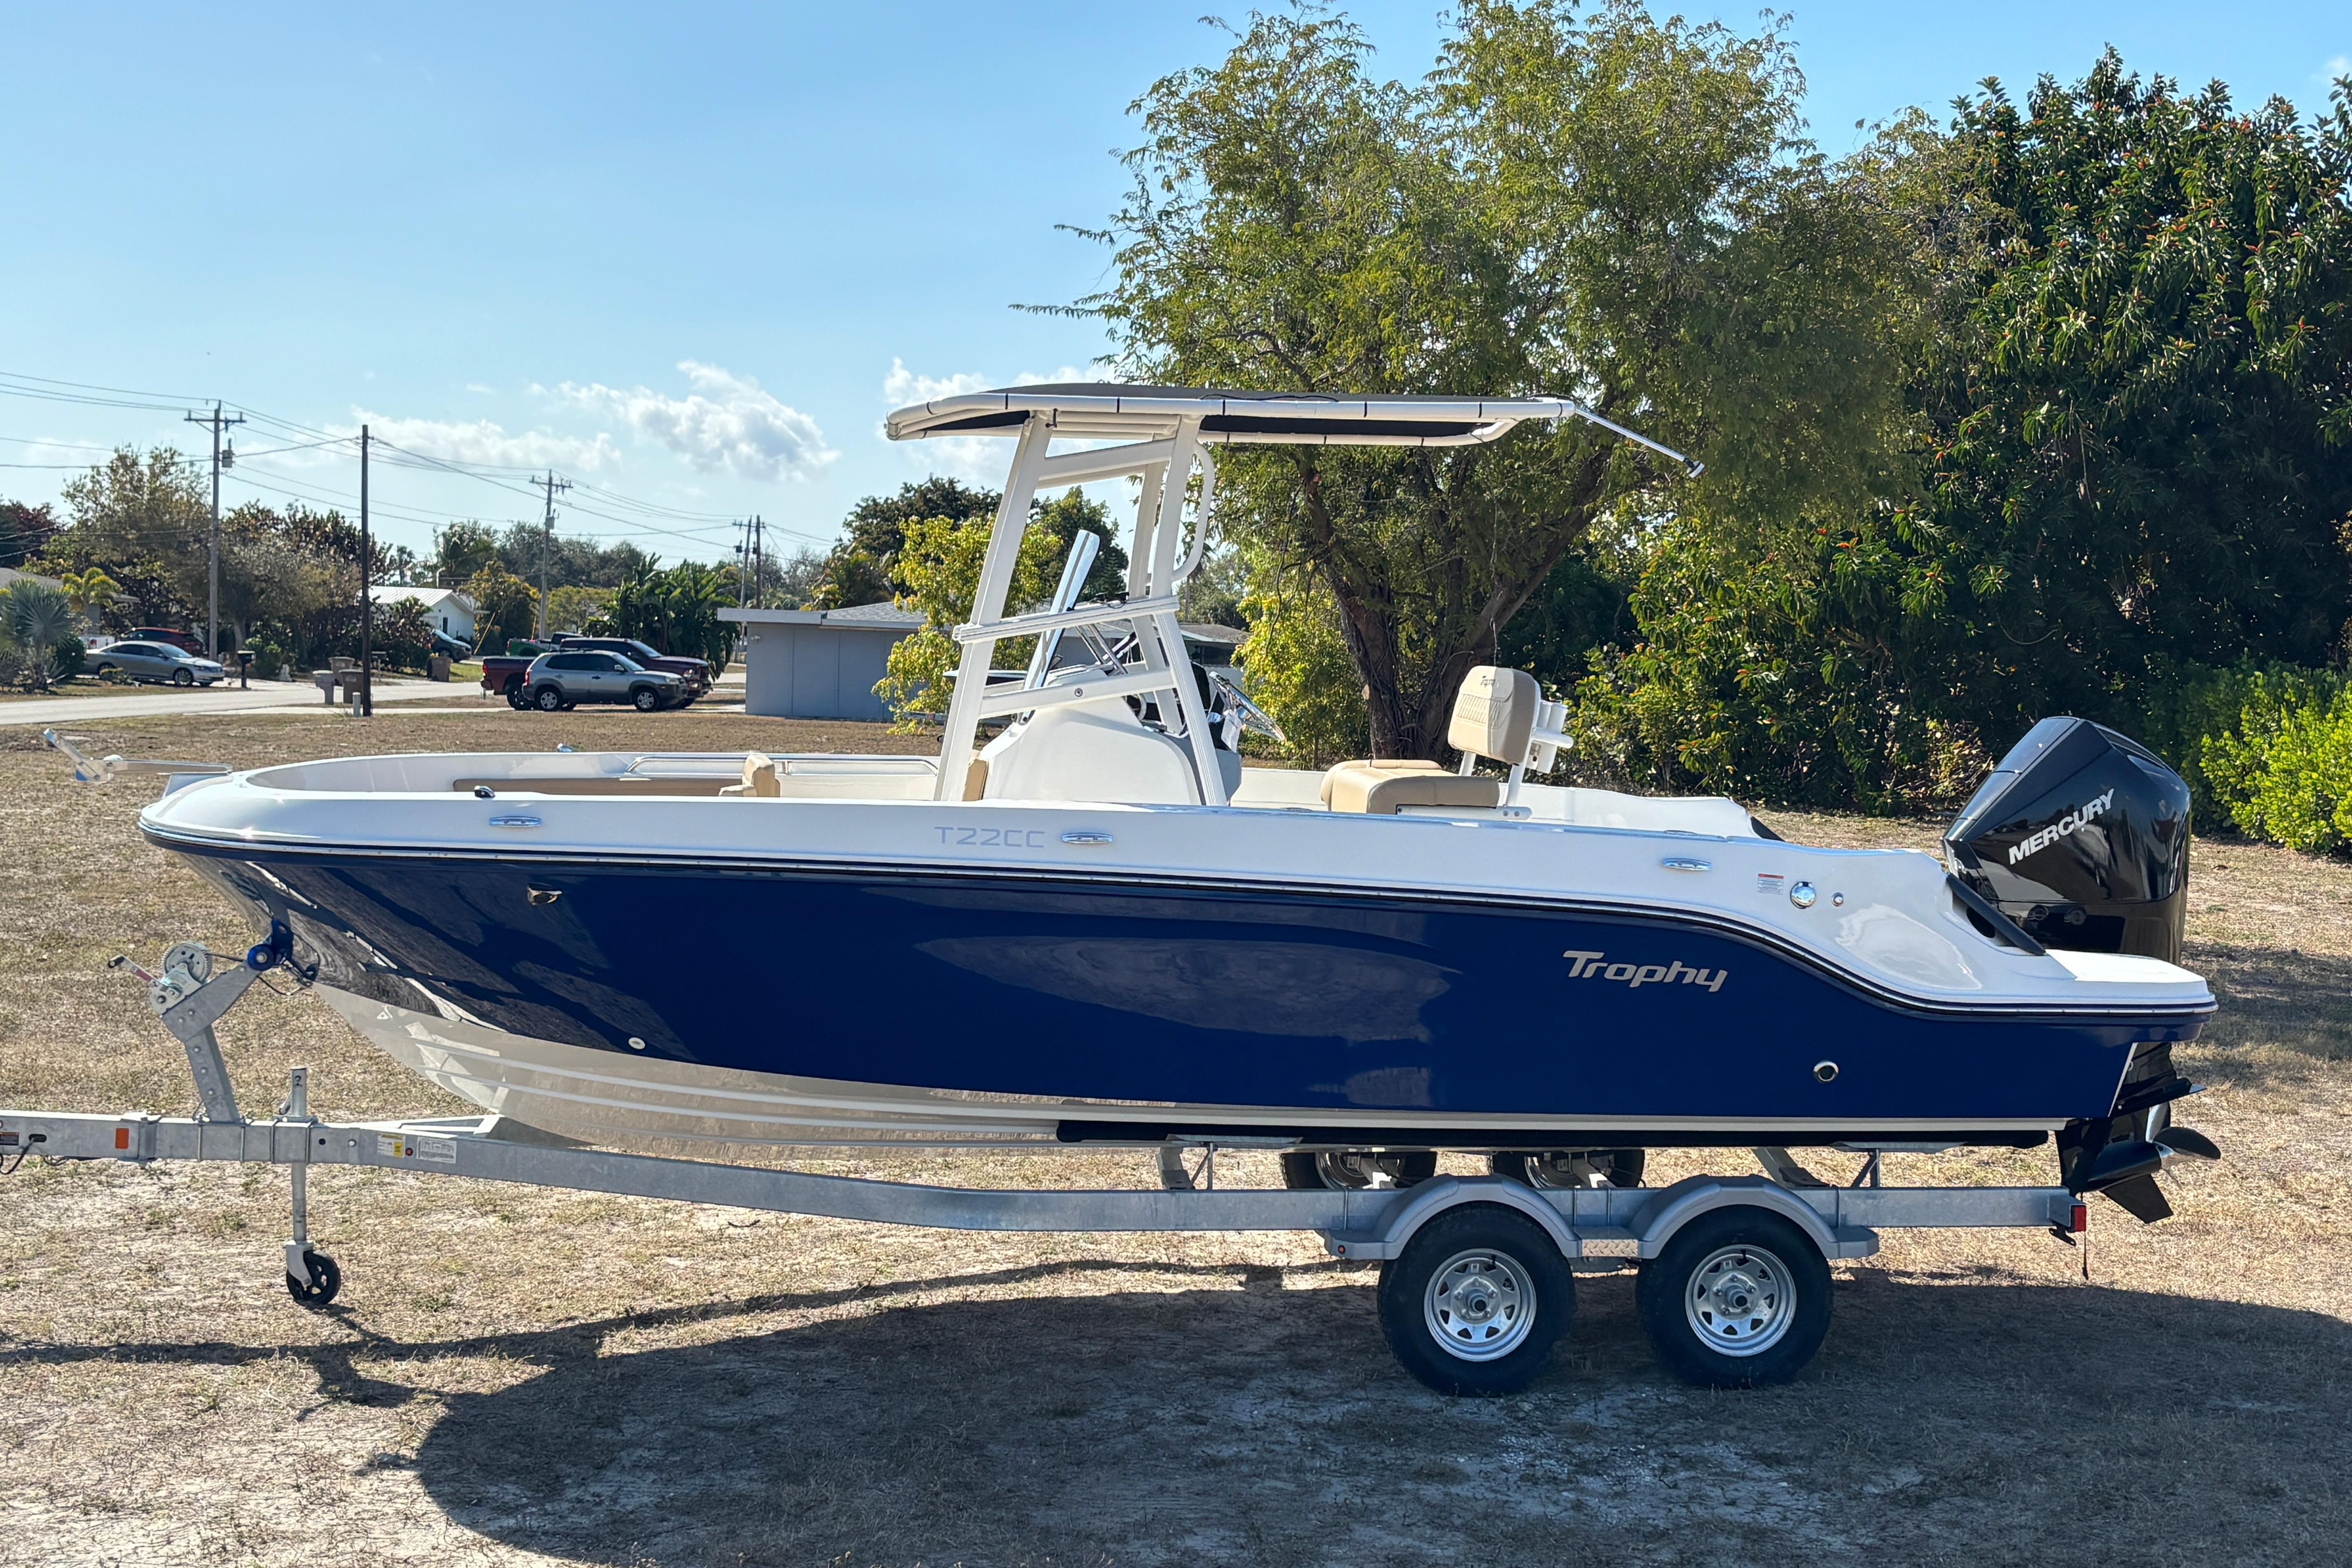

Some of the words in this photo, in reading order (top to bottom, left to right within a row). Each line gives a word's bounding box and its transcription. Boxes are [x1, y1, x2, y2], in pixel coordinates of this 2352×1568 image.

[934, 826, 1045, 848] T22CC
[2009, 789, 2114, 865] MERCURY
[1563, 950, 1728, 992] Trophy
